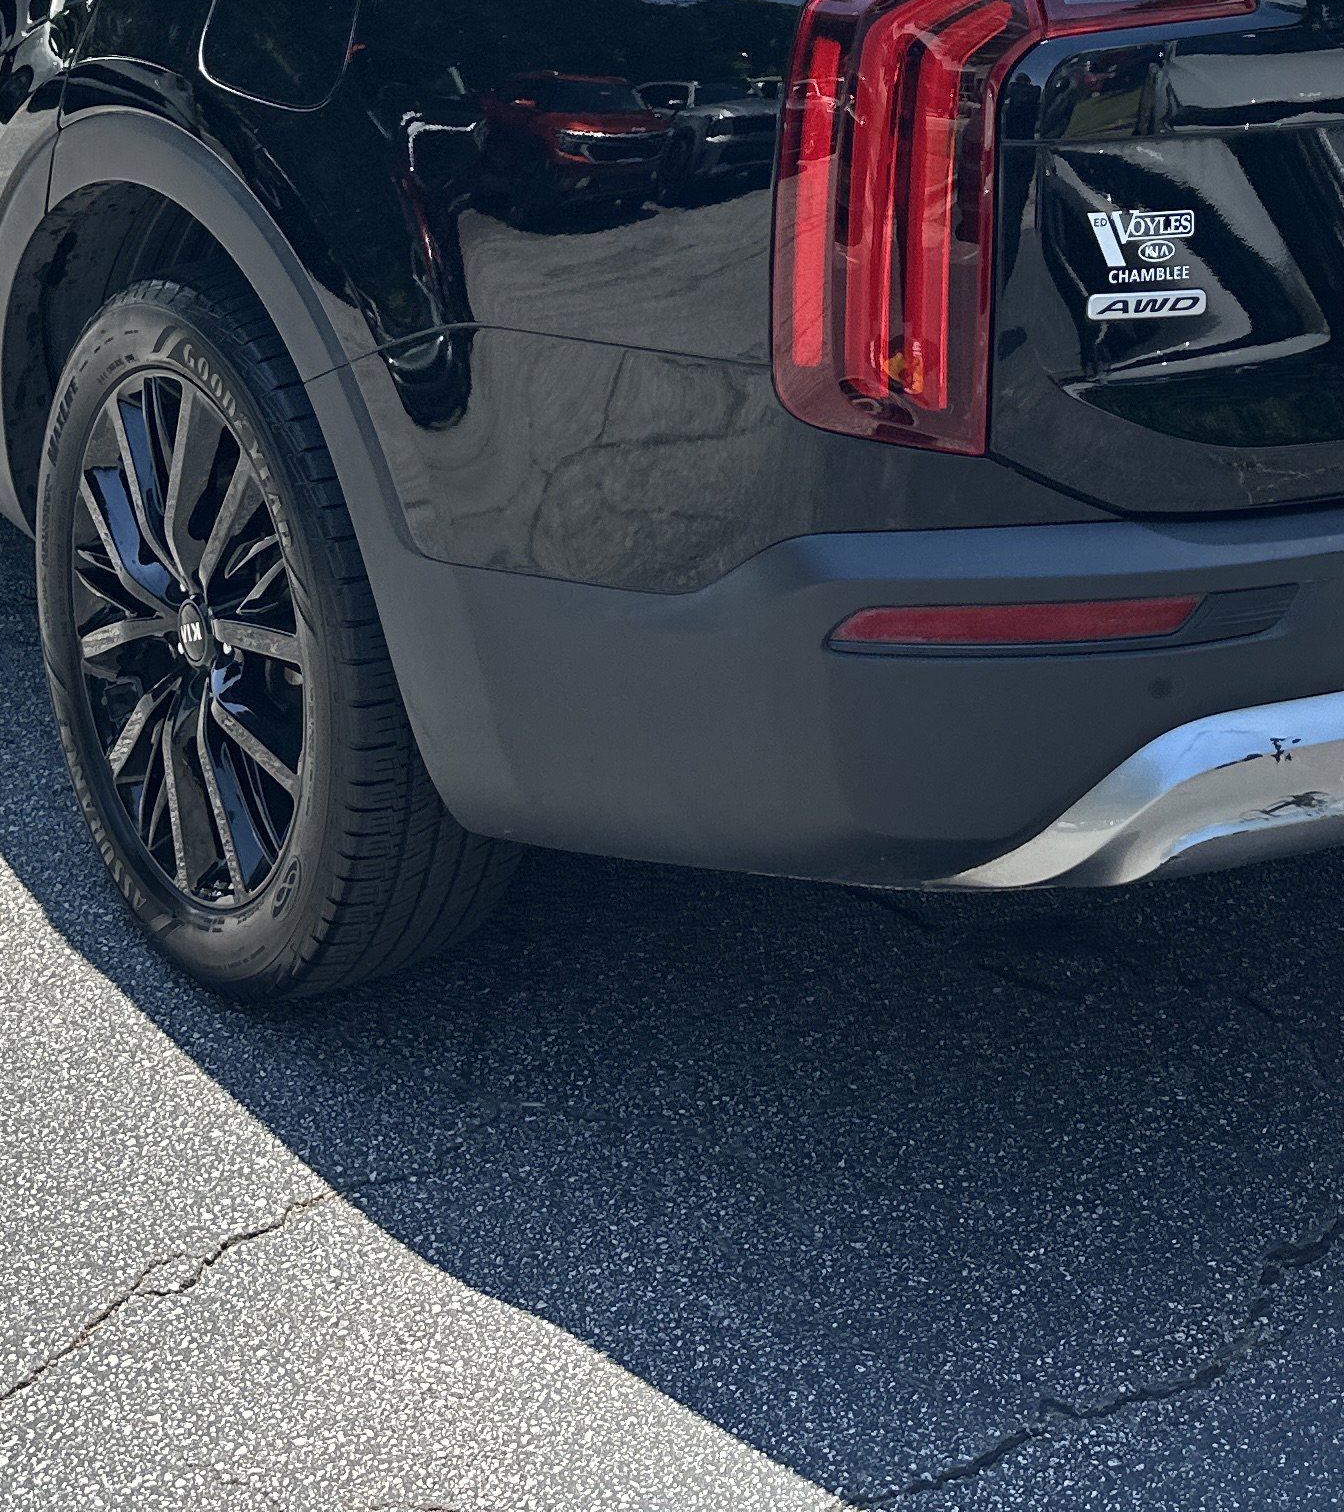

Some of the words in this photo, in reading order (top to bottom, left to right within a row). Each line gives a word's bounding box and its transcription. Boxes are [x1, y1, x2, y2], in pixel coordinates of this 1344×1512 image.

[1093, 217, 1108, 228] ED
[1111, 210, 1192, 245] VOYLES
[1144, 245, 1170, 258] KIA
[1108, 266, 1190, 284] CHAMBLEE
[1096, 296, 1200, 315] AWD
[180, 621, 203, 644] KIA
